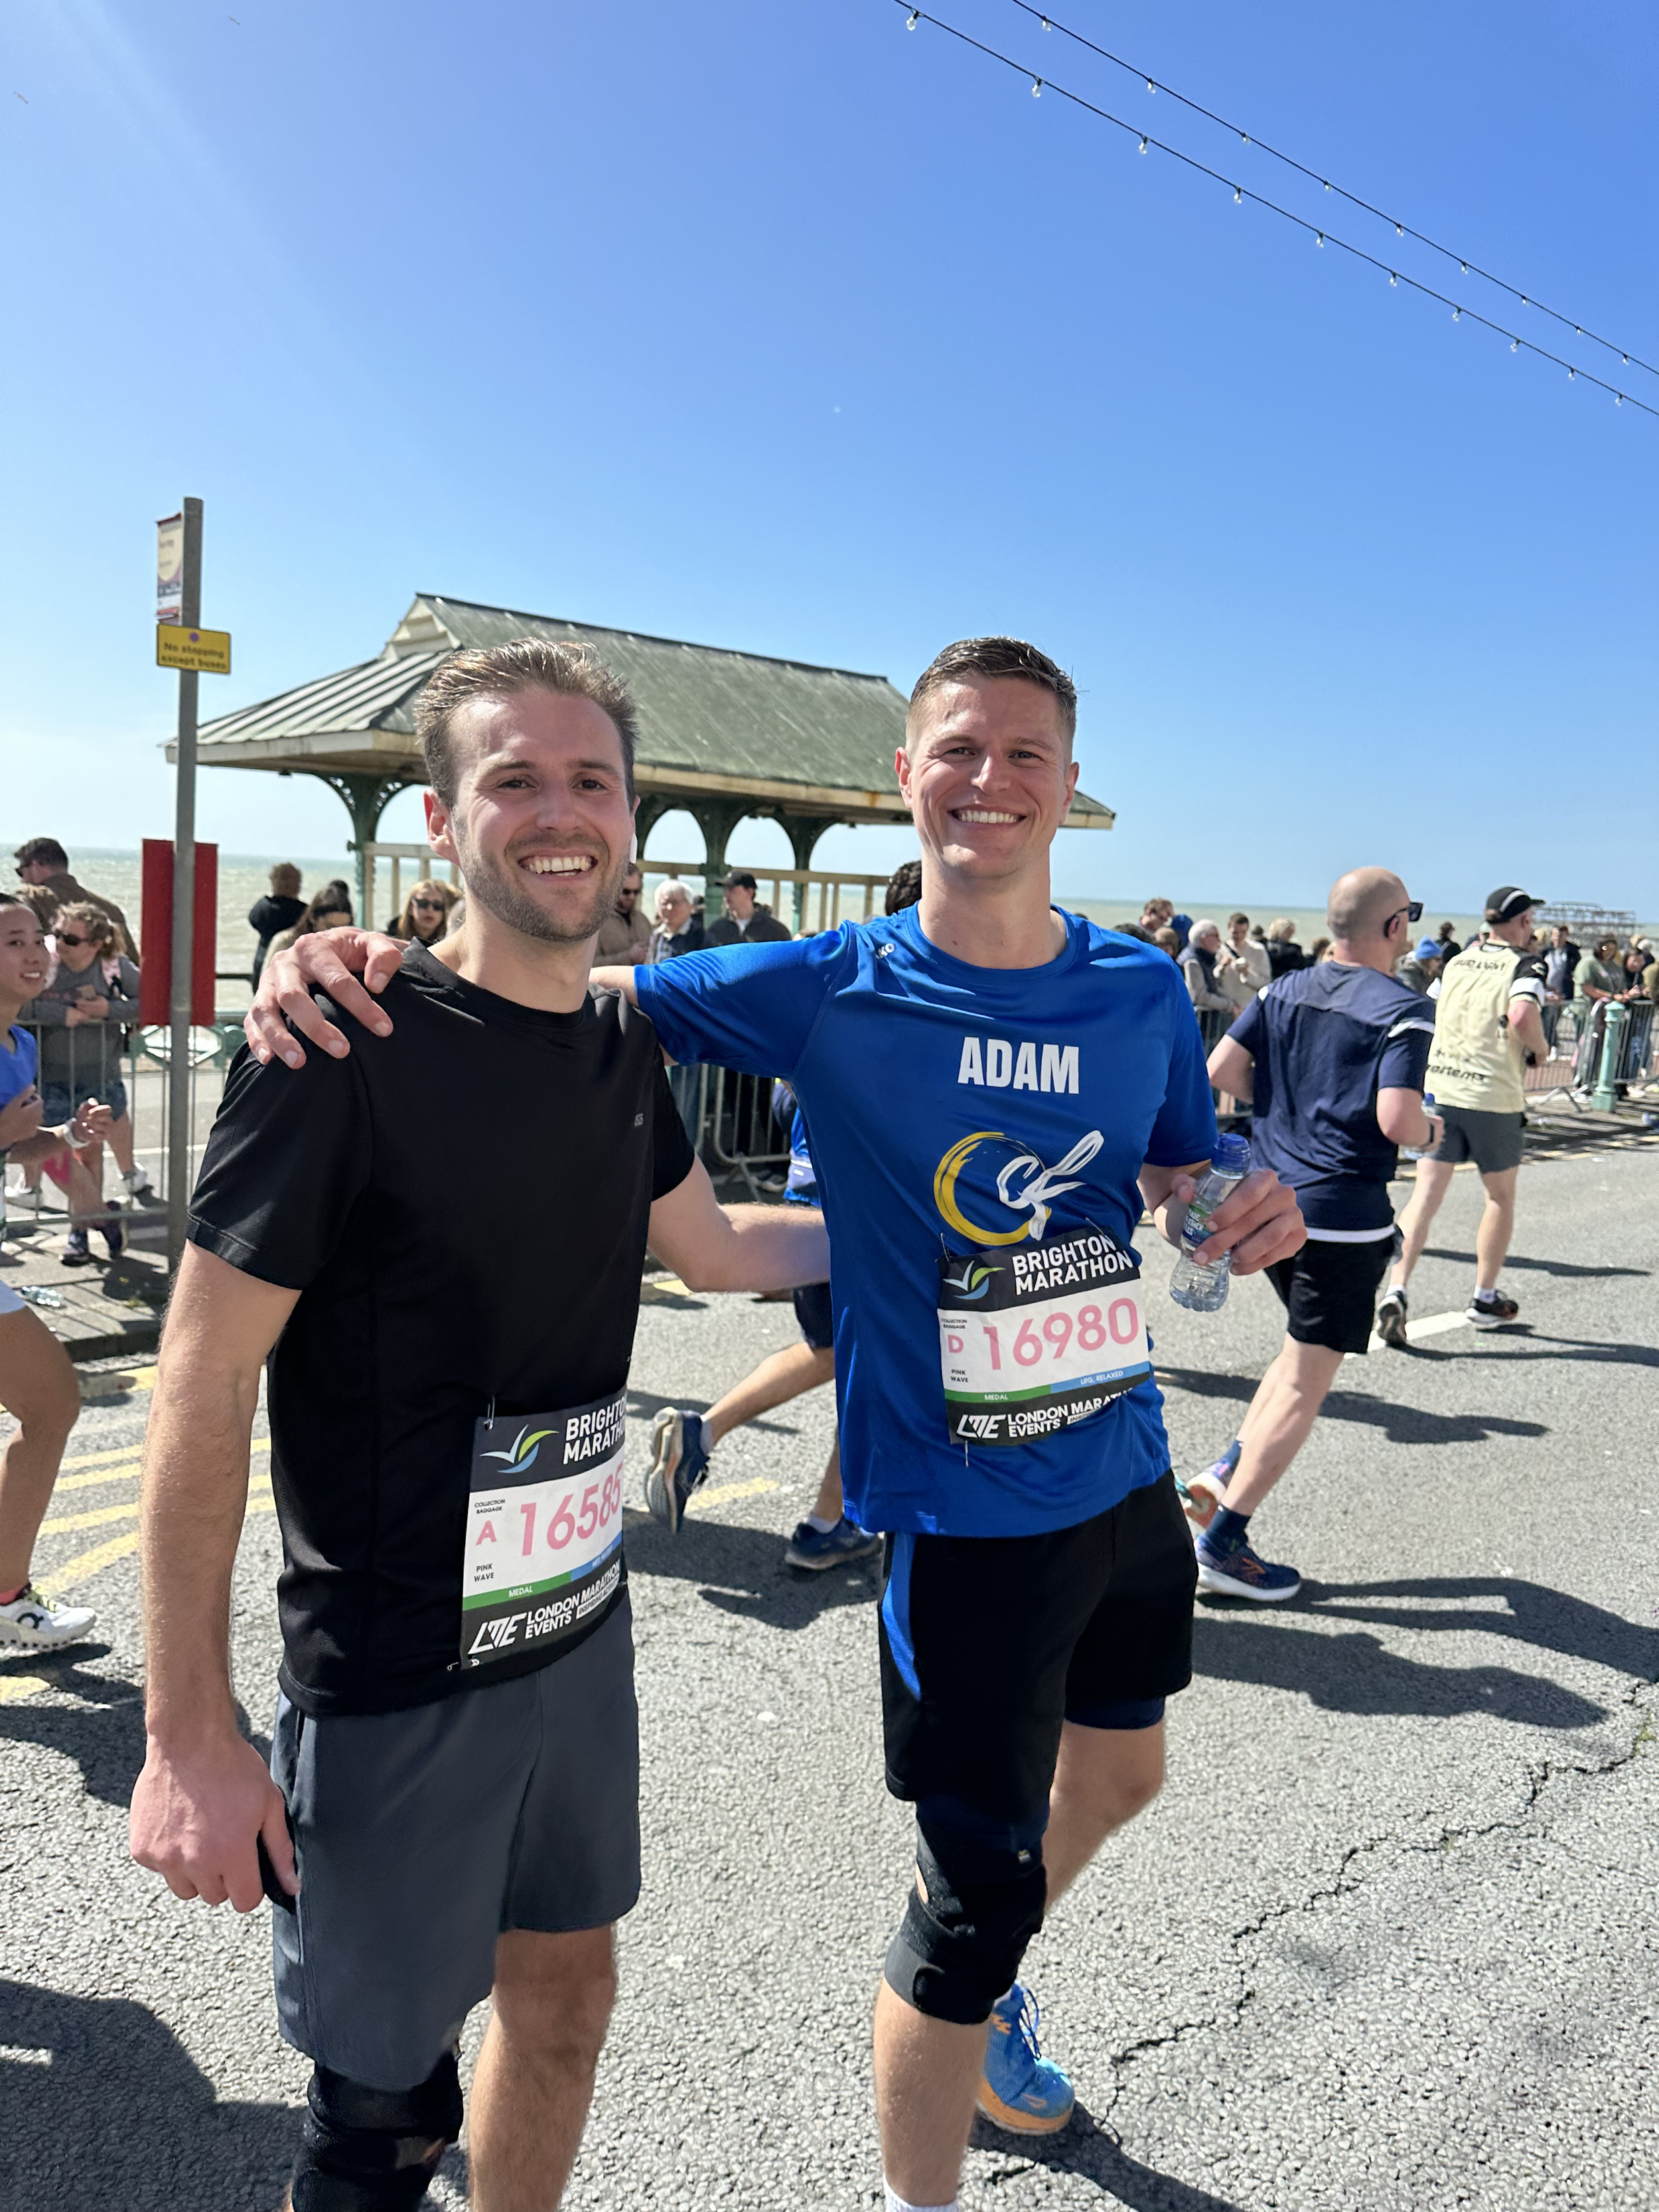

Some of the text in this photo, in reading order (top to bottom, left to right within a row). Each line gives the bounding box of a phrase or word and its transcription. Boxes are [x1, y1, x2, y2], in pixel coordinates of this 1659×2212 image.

[163, 642, 224, 659] No stopping
[161, 654, 226, 669] except buses
[958, 1037, 1079, 1094] ADAM
[1012, 1234, 1116, 1276] BRIGHTON
[1015, 1250, 1133, 1295] MARATHON
[948, 1297, 1139, 1370] D 16980
[1096, 1370, 1124, 1382] RELAXED
[566, 1396, 626, 1441] BRIGHTO
[1007, 1405, 1068, 1426] LONDON
[1008, 1418, 1060, 1438] EVENTS
[563, 1416, 625, 1465] MARATHO
[474, 1499, 506, 1508] COLLECTION
[476, 1461, 623, 1556] A 16585
[476, 1506, 502, 1514] BAGGAGE
[474, 1572, 494, 1582] WAVE
[476, 1563, 493, 1572] PINK
[509, 1585, 533, 1597] MEDAL
[528, 1558, 620, 1625] LONDON MARATHON
[525, 1610, 572, 1639] EVENTS
